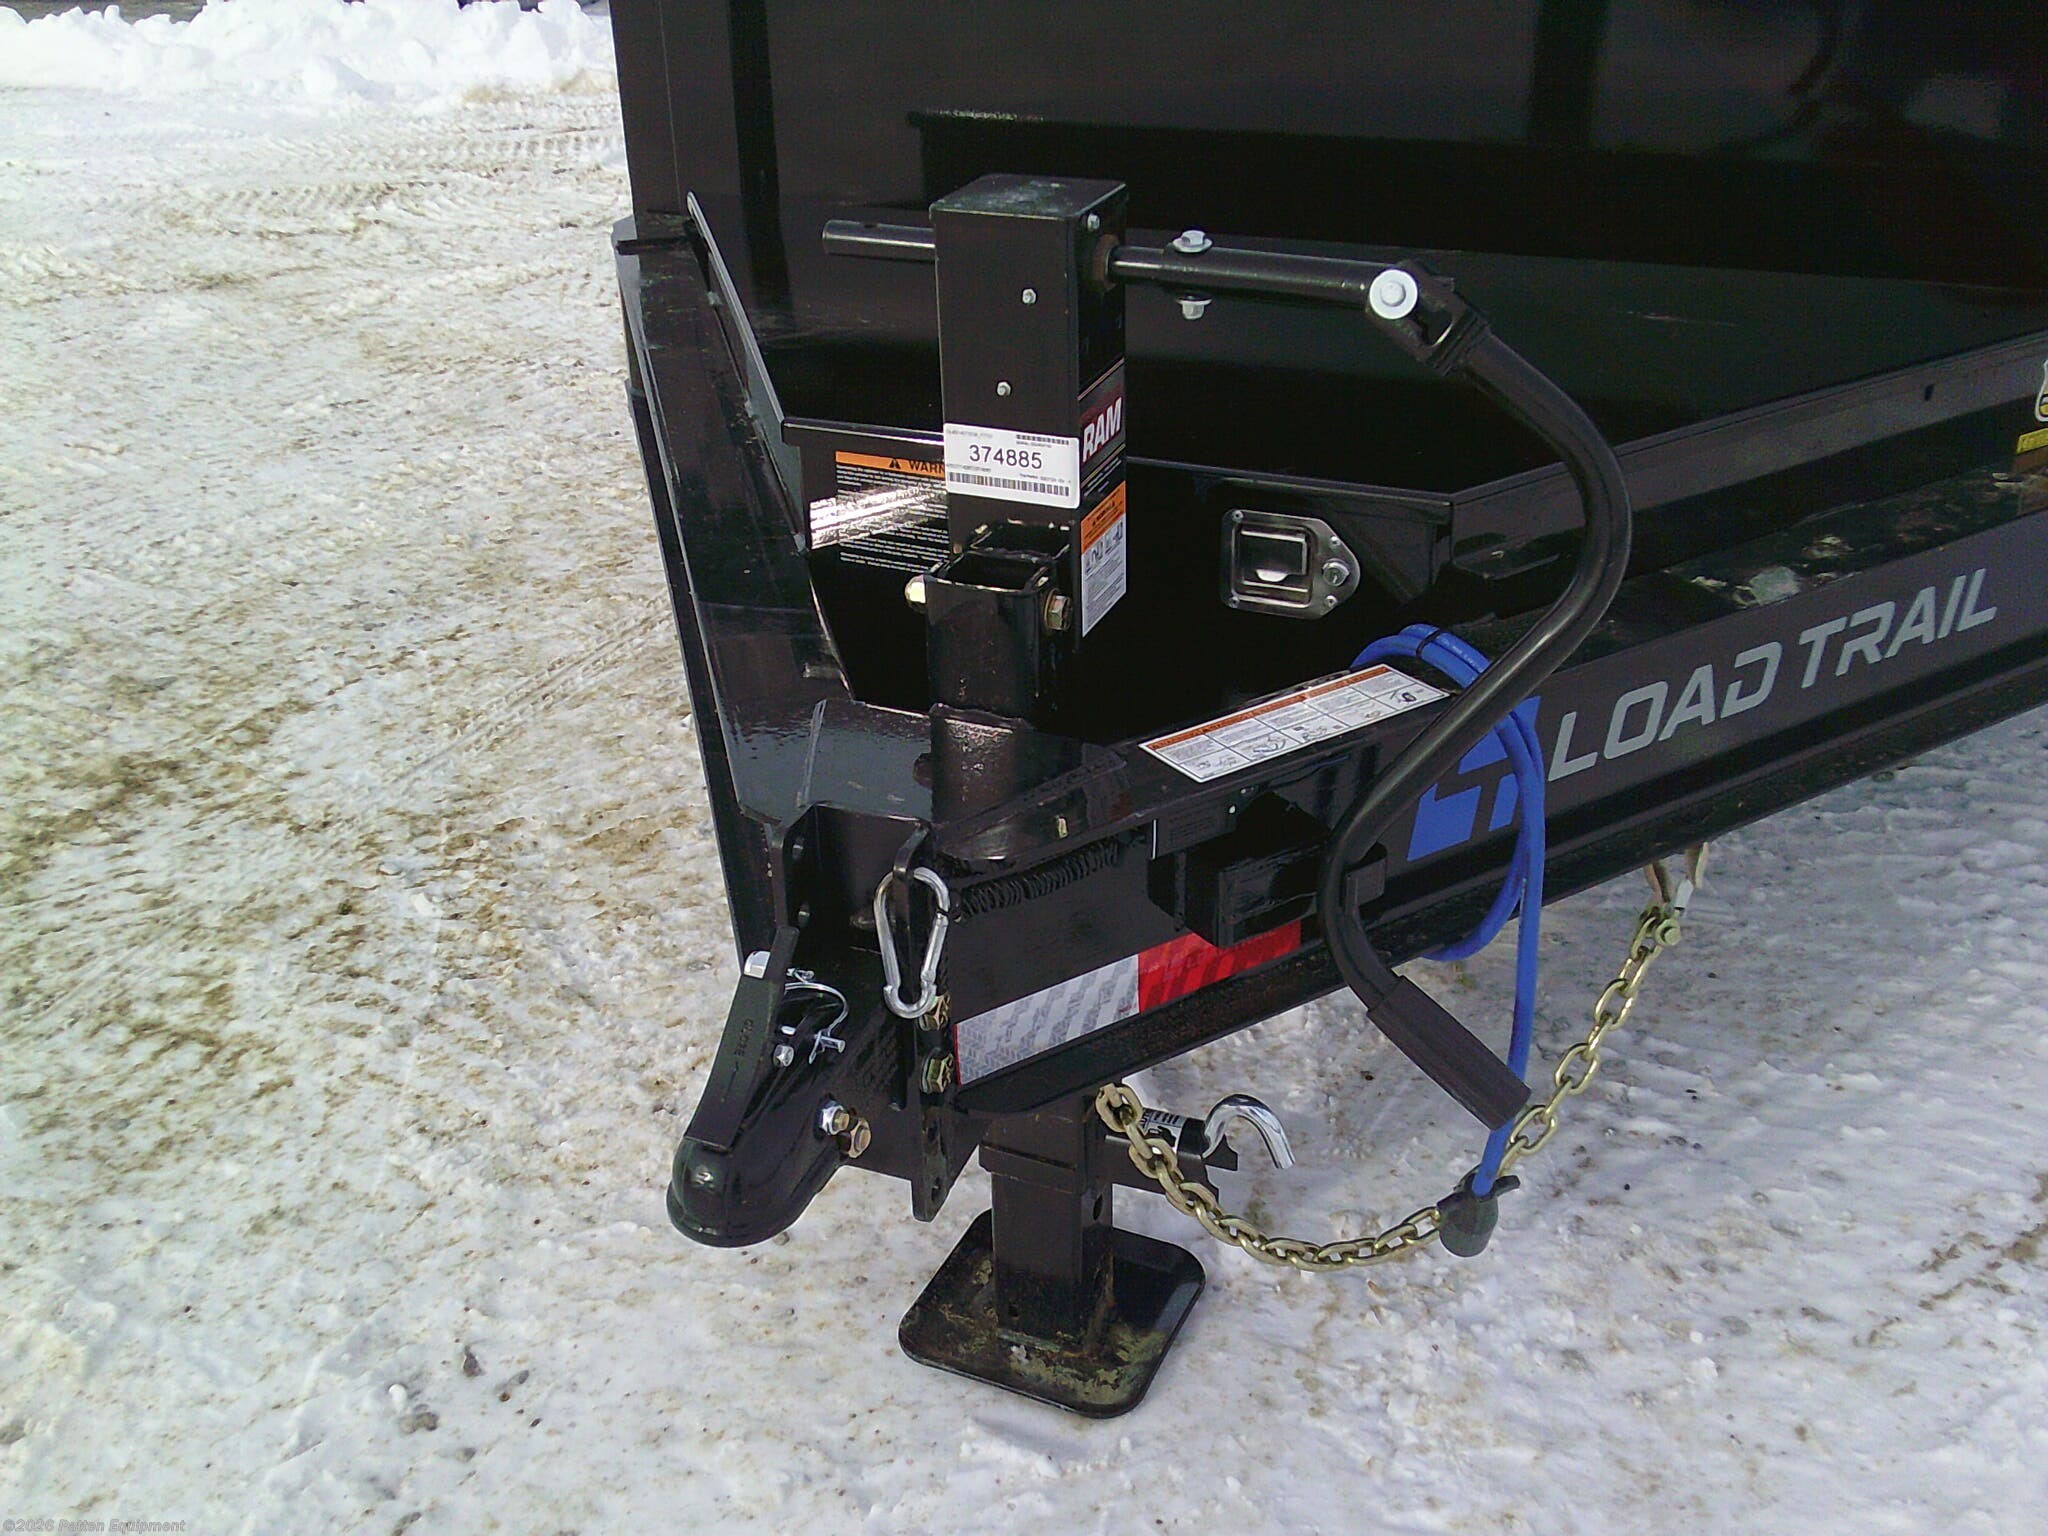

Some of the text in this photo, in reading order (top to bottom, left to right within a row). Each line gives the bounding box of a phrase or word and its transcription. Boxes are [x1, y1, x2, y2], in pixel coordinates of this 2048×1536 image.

[968, 444, 1042, 470] 374885
[1082, 397, 1122, 463] RAM
[1547, 641, 1783, 782] LOAD
[1799, 567, 1998, 689] TRAIL
